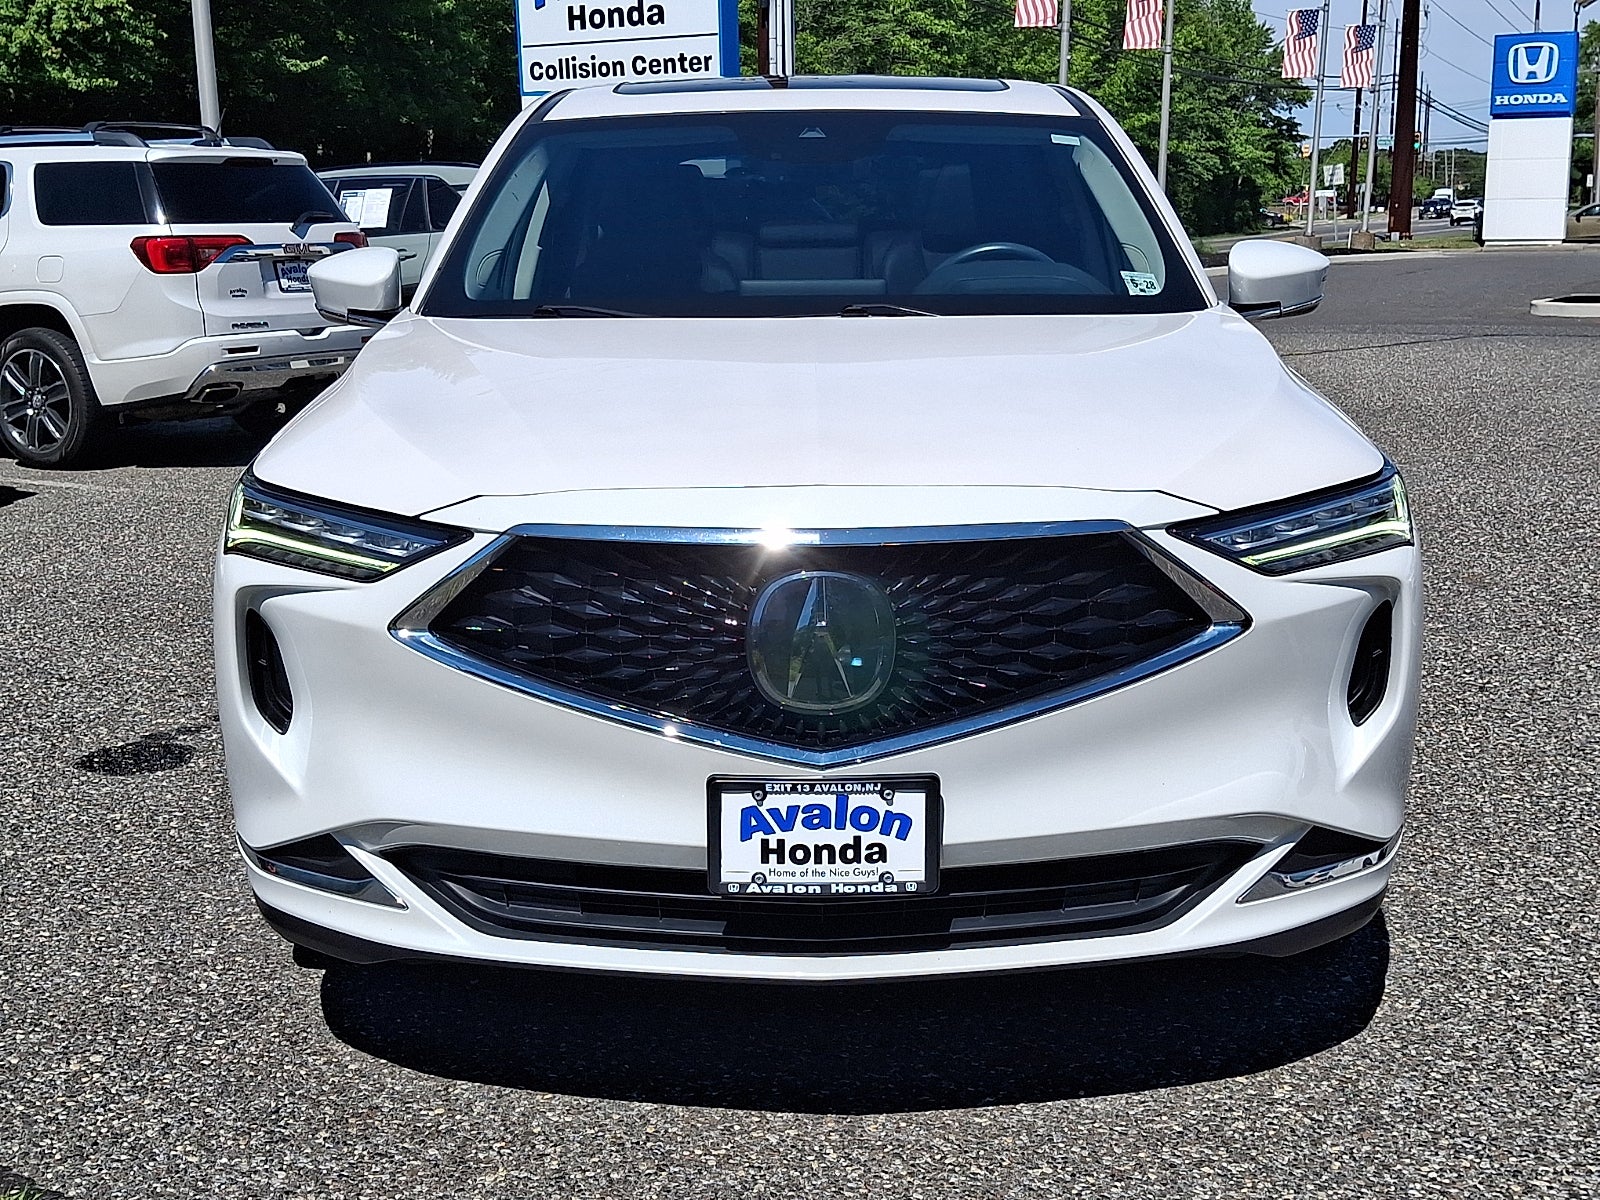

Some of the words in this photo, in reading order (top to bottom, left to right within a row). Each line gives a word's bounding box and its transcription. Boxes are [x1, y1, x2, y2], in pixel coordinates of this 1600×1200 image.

[568, 0, 665, 31] Honda
[530, 55, 625, 81] Collision
[631, 53, 713, 76] Center
[1494, 93, 1568, 106] HONDA
[281, 263, 307, 277] Avalo
[765, 783, 793, 792] EXIT
[797, 784, 810, 792] 13
[740, 793, 913, 842] Avalon
[760, 835, 888, 865] Honda
[769, 868, 797, 877] Home
[800, 868, 809, 877] of
[812, 868, 828, 877] the
[829, 868, 850, 877] Nice
[853, 867, 879, 879] Guys!
[746, 882, 822, 894] Avalon
[830, 882, 898, 893] Honda
